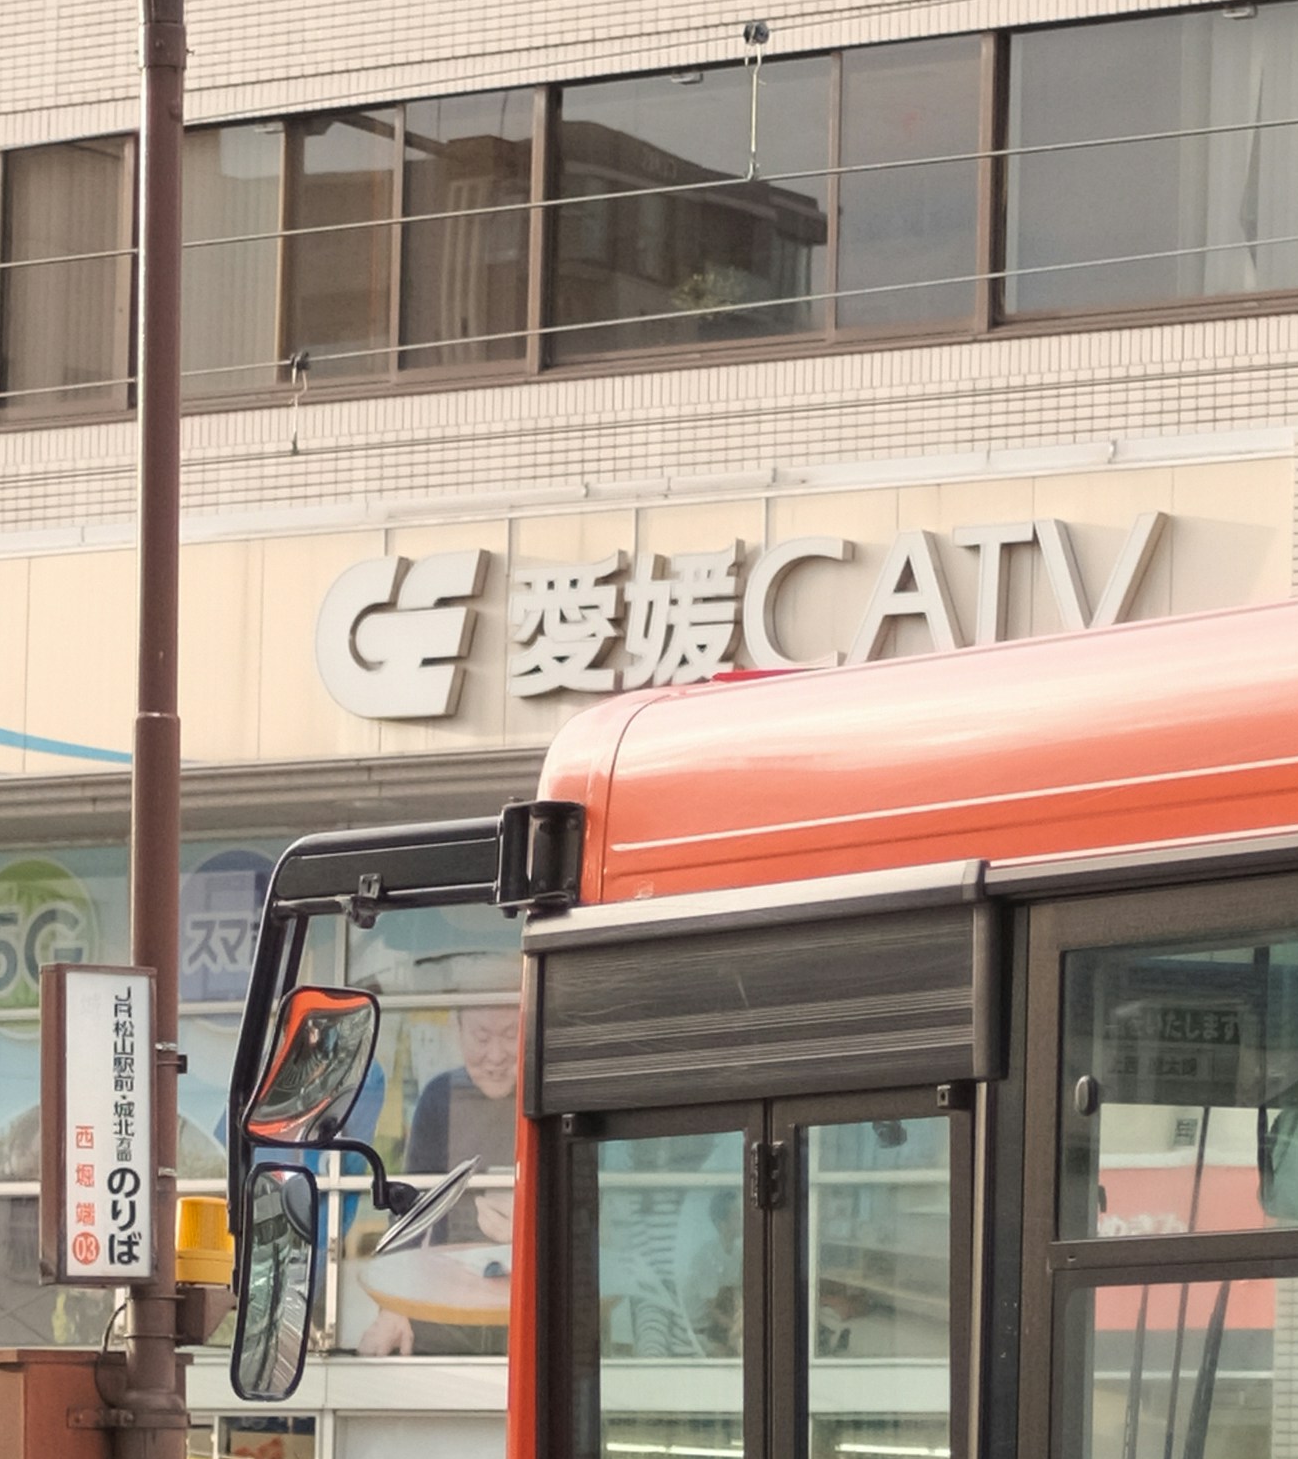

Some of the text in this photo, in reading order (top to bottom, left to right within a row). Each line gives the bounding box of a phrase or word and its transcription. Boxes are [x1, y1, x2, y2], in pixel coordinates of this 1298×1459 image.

[510, 511, 1167, 698] 愛媛CATV
[74, 1125, 97, 1260] 西堀端 03
